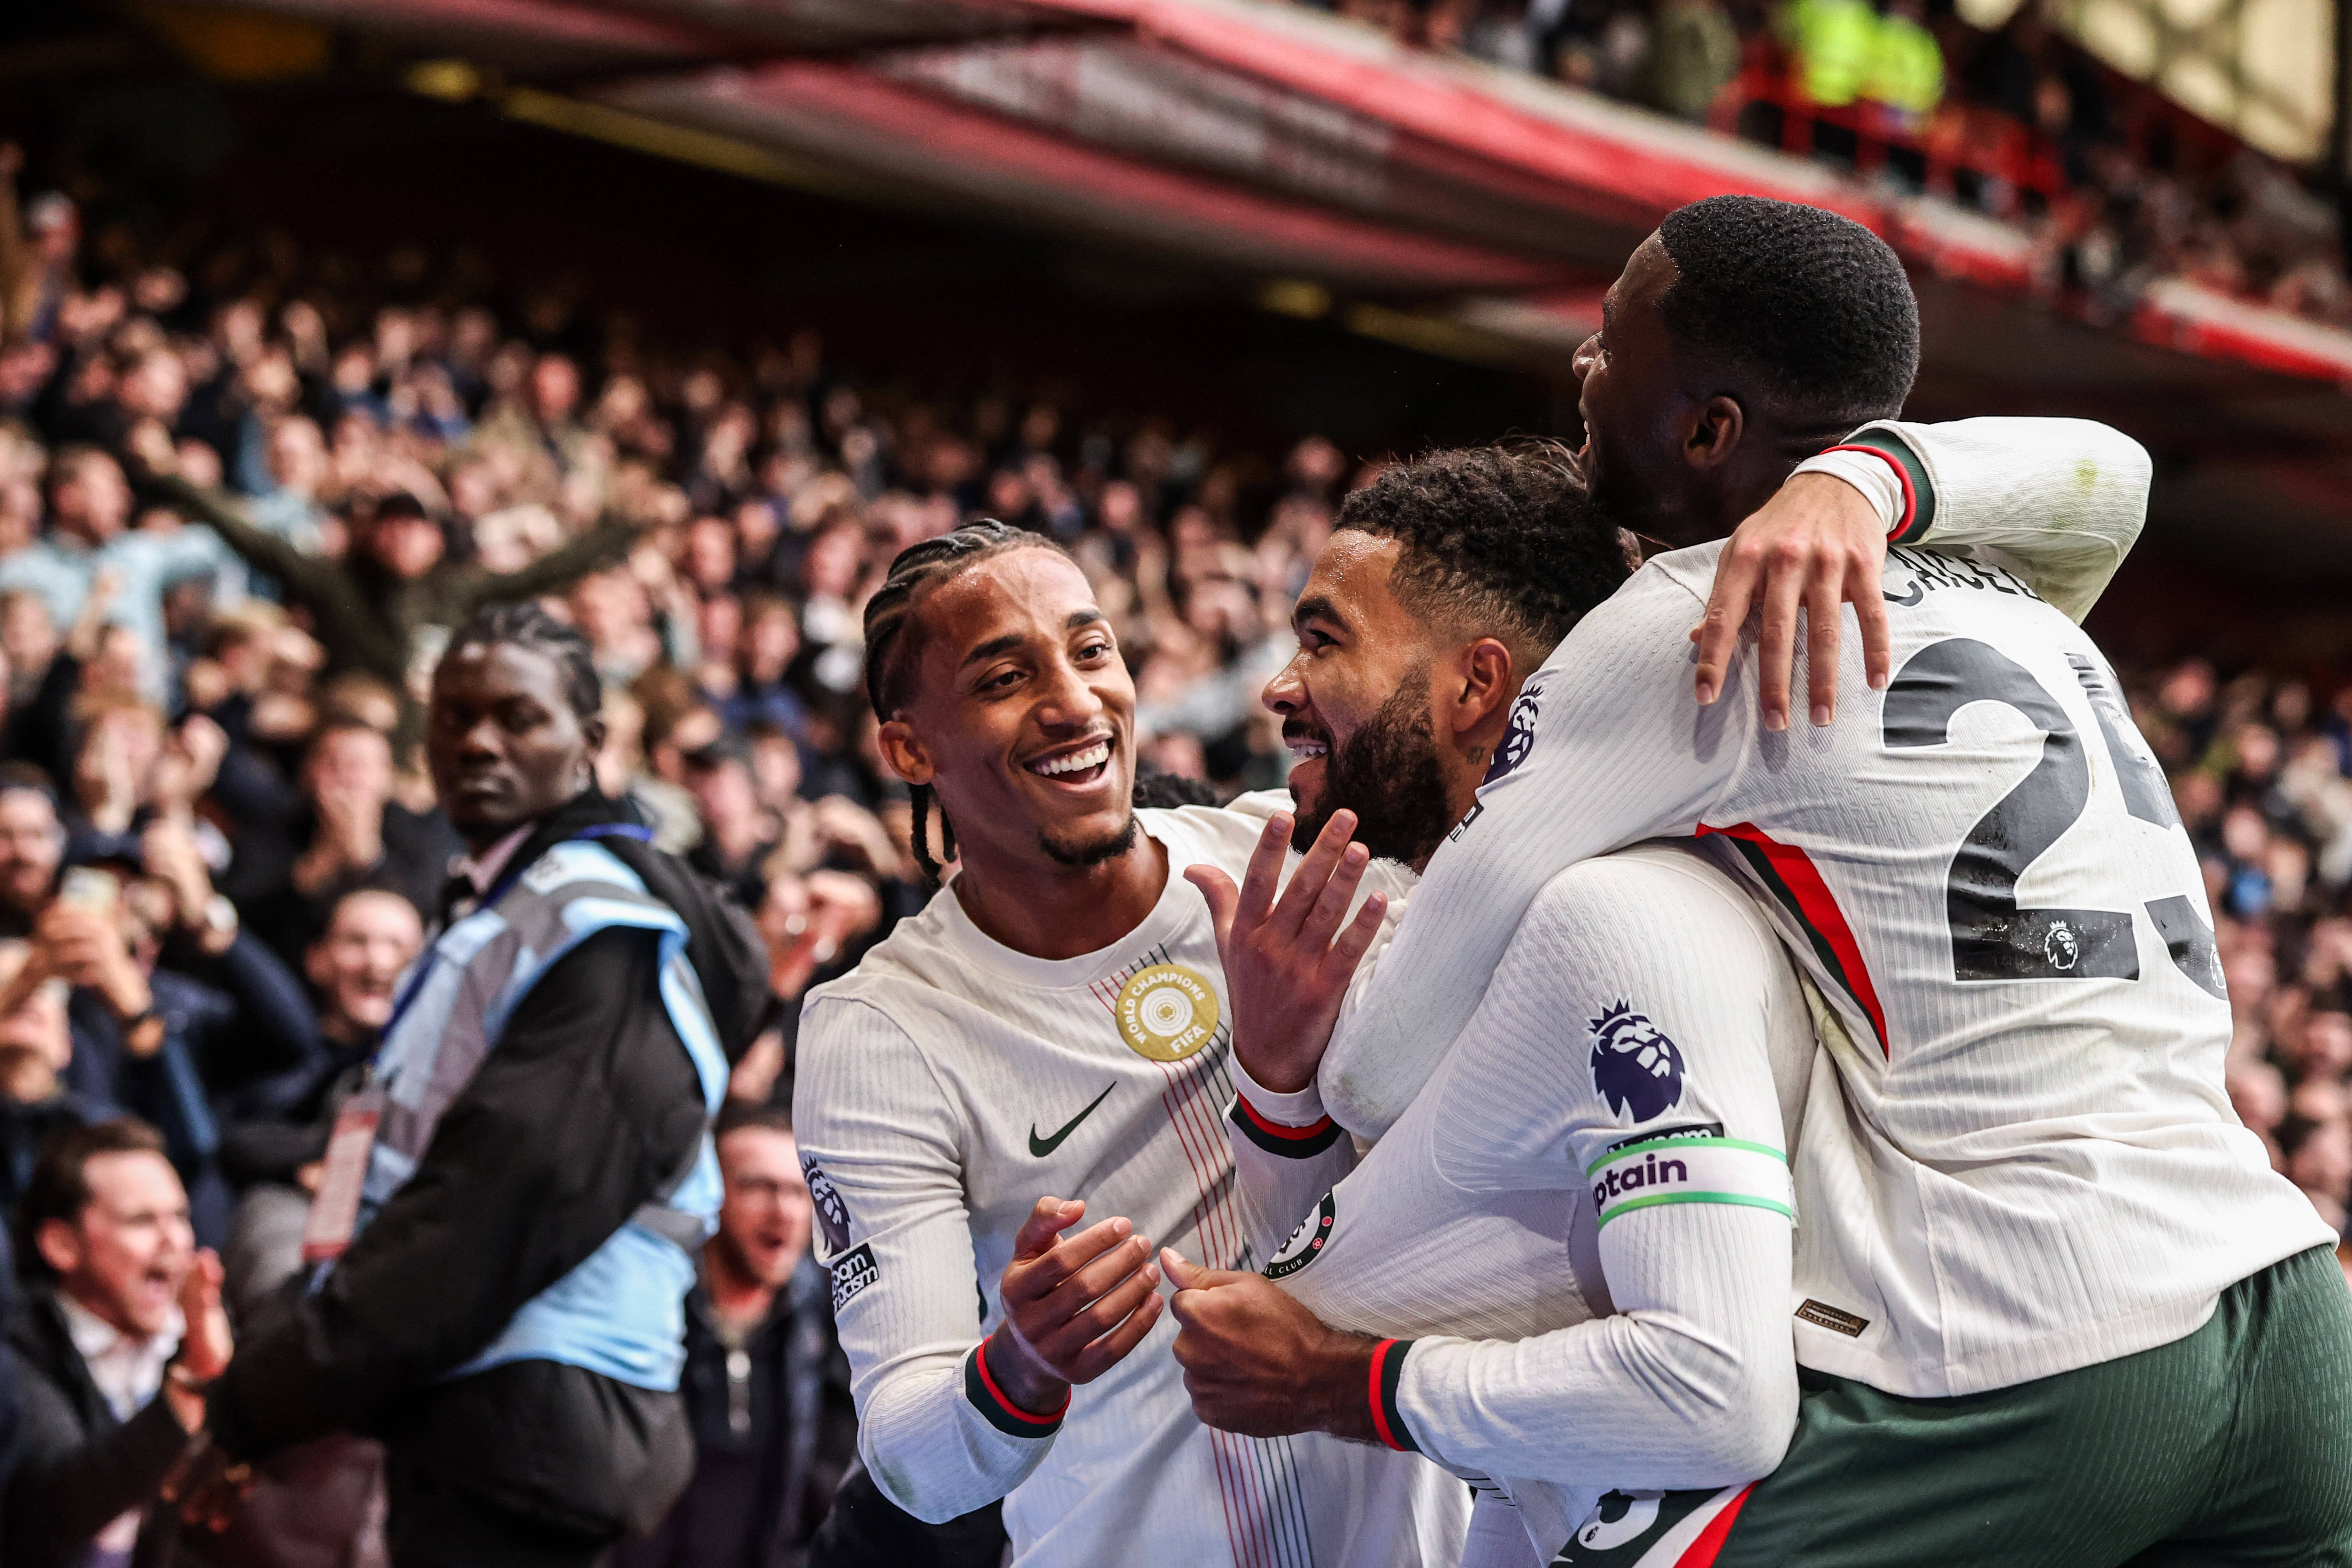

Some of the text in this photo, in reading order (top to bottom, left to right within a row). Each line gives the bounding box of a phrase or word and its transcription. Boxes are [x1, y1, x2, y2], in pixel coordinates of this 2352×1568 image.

[1124, 972, 1206, 1044] WORLD CHAMPIONS
[1170, 1023, 1207, 1054] FIFA
[1593, 1153, 1687, 1217] ptain
[1278, 1258, 1302, 1274] CLUB
